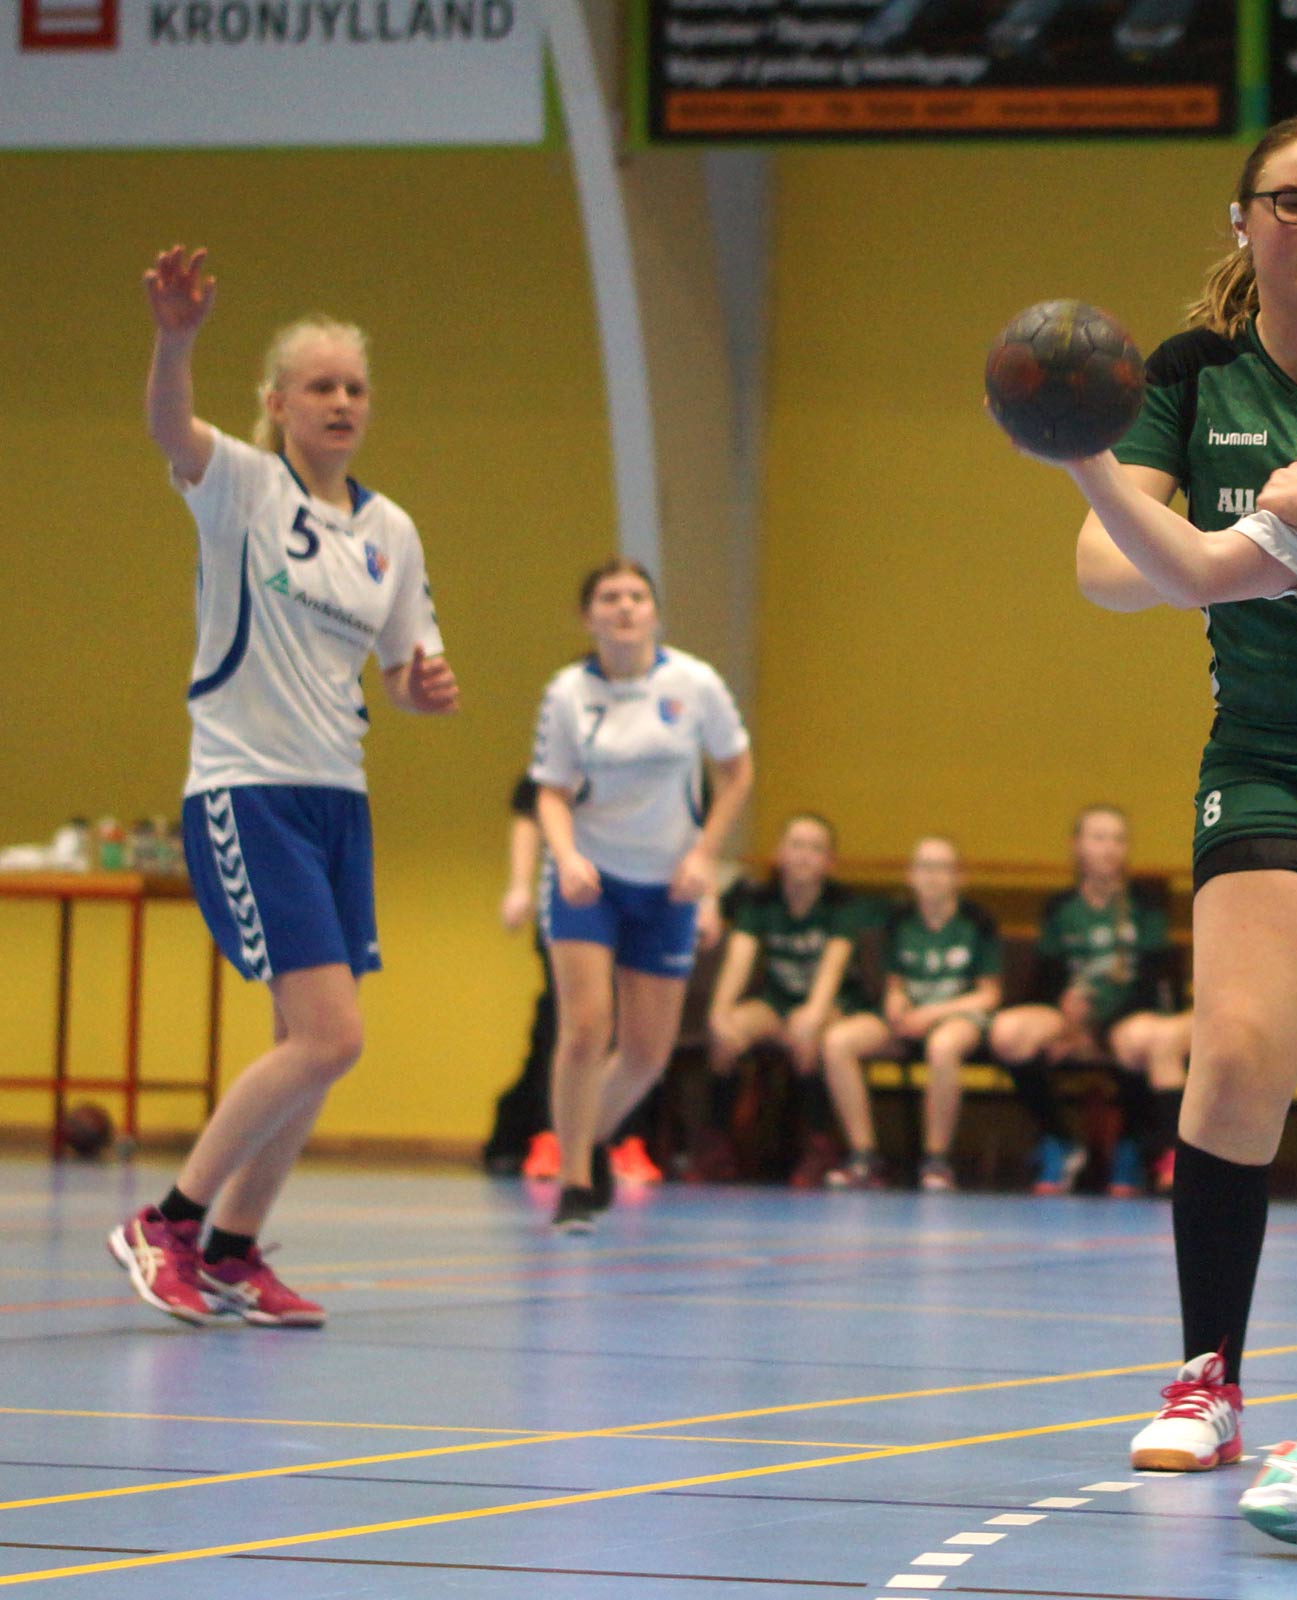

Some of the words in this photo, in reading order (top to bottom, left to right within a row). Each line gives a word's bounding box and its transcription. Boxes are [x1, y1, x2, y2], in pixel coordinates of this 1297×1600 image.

[150, 0, 514, 43] KRONJYLLAND
[1208, 428, 1268, 446] hummel
[286, 505, 320, 560] 5
[583, 704, 607, 747] 7
[1203, 790, 1222, 827] 8
